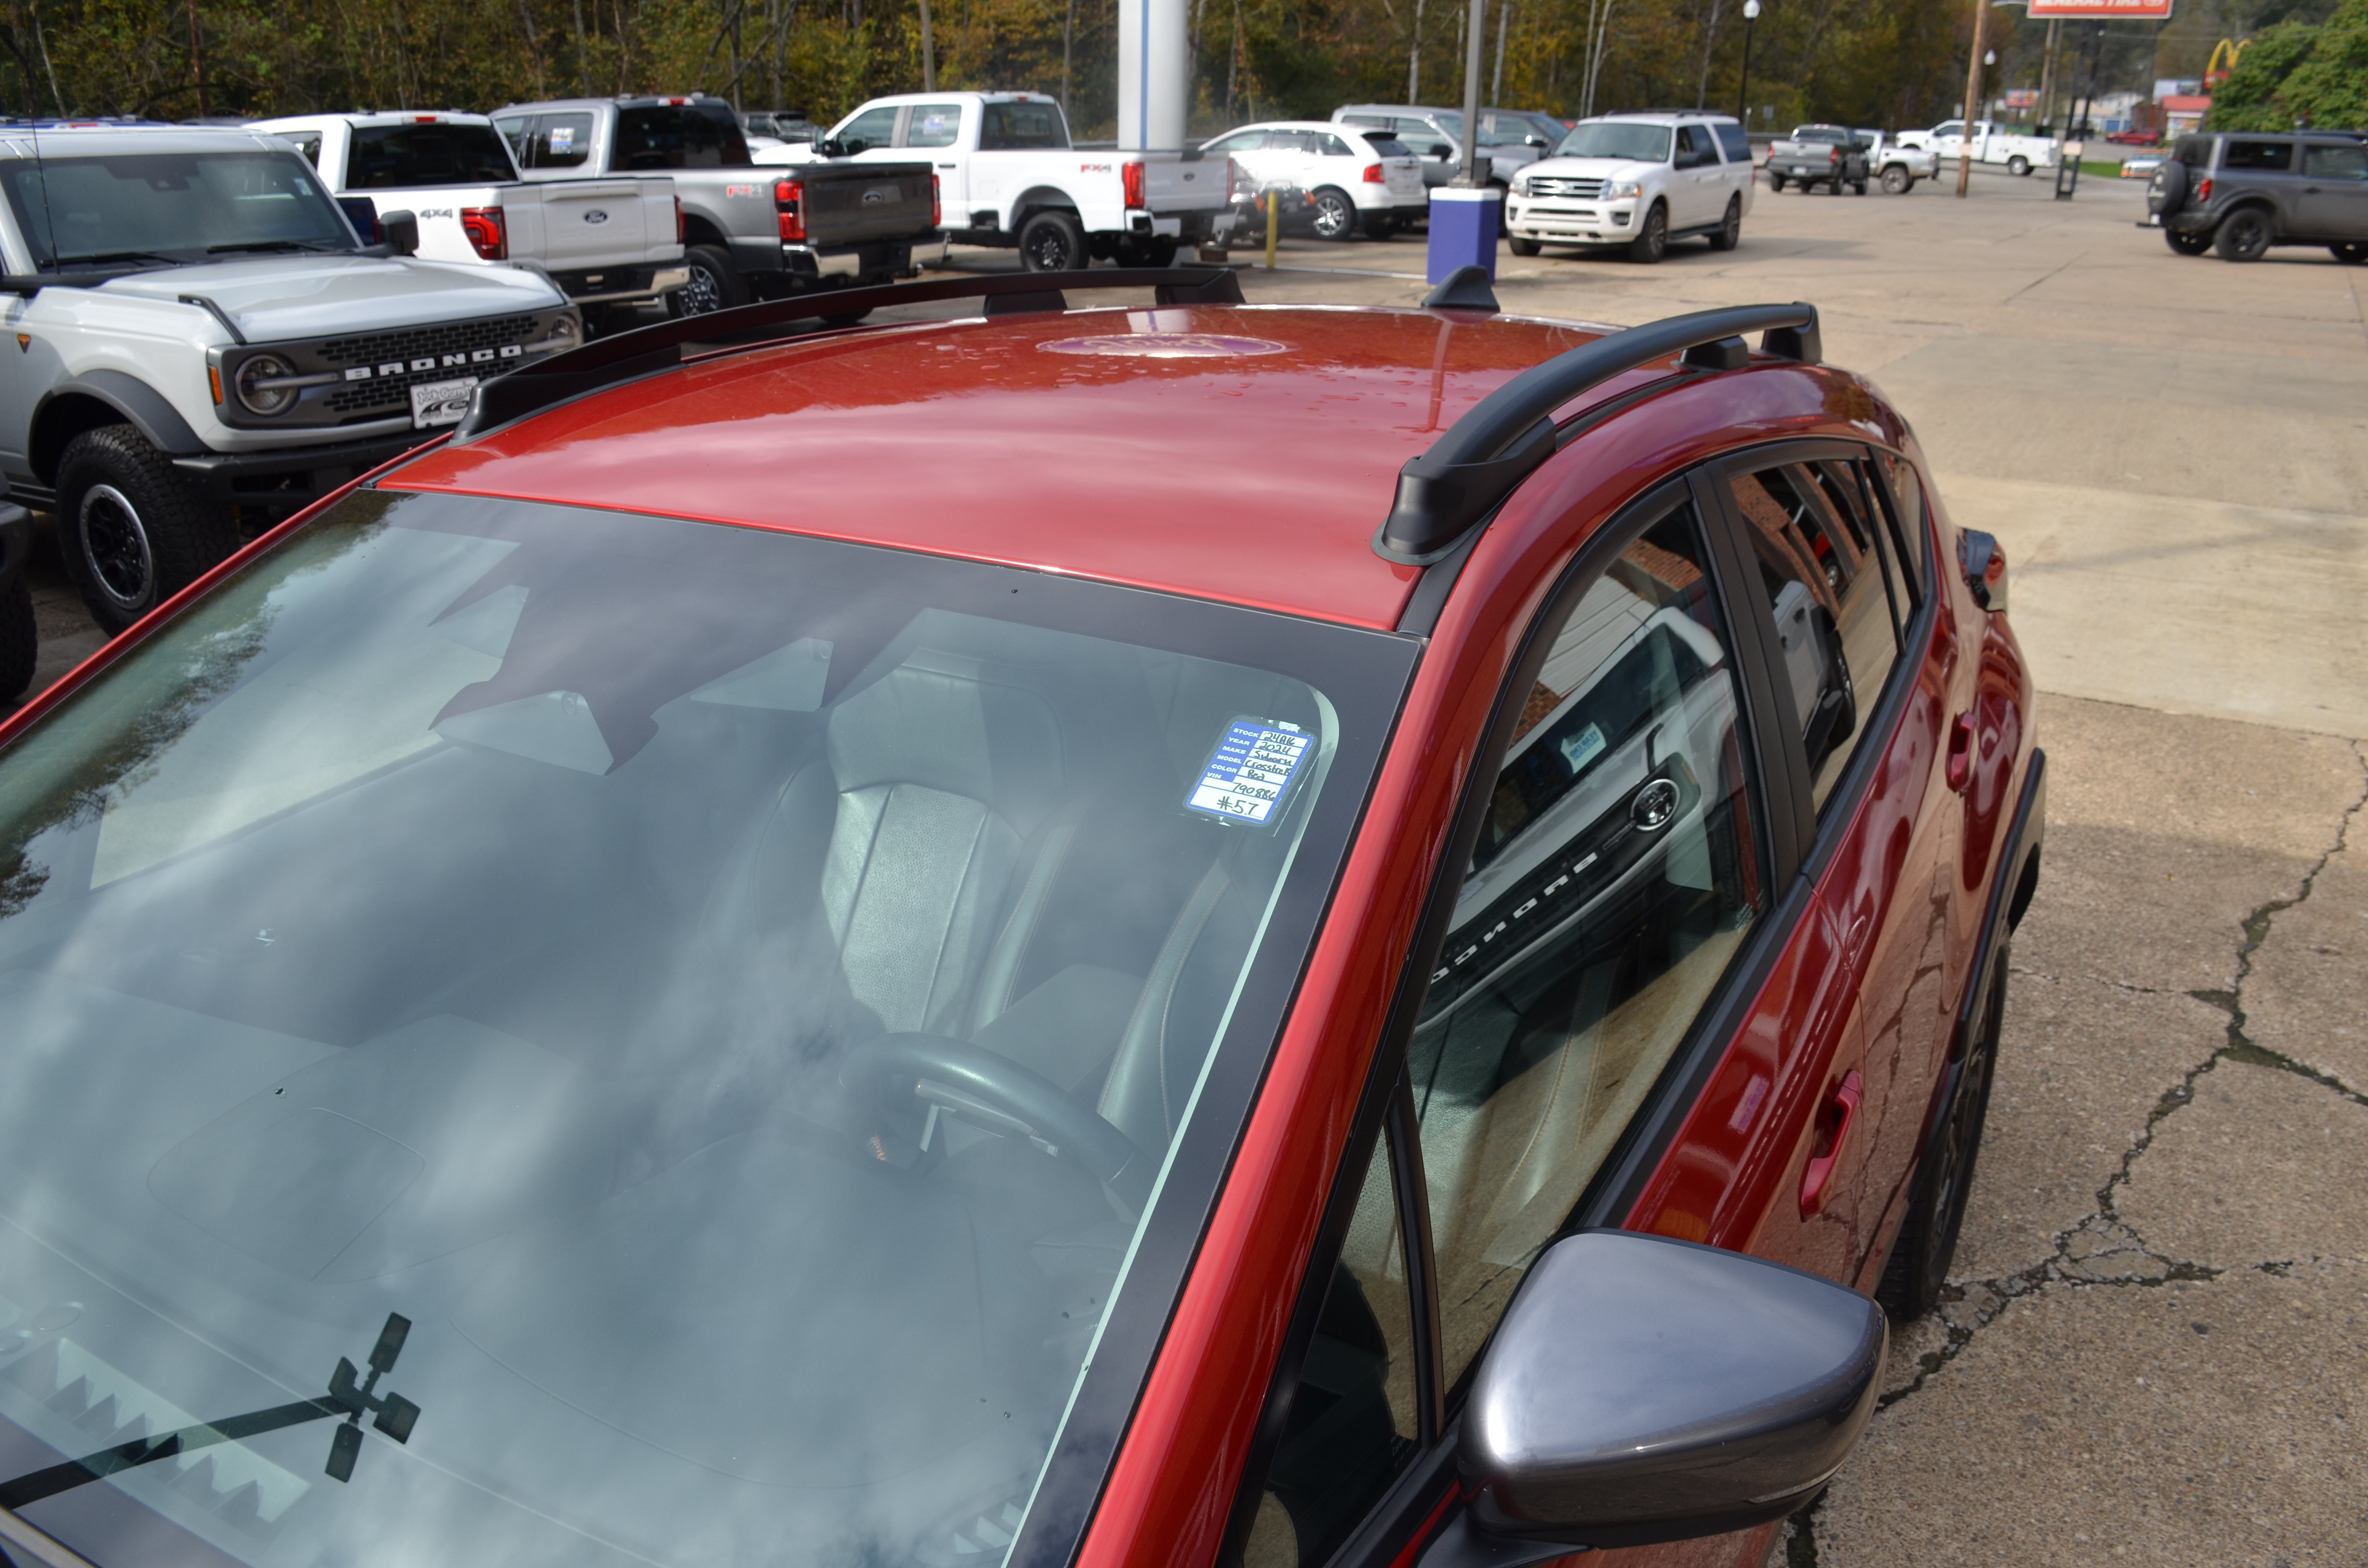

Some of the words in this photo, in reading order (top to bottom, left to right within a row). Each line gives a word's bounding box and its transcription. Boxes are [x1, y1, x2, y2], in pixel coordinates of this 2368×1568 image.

[345, 344, 521, 381] BRONCO
[1233, 728, 1259, 738] STOCK
[1222, 746, 1246, 754] MAKE
[1228, 737, 1250, 746] YEAR
[1258, 741, 1292, 754] 2024
[1217, 755, 1242, 764] MODEL
[1211, 764, 1237, 773] COLOR
[1247, 769, 1265, 781] Red
[1217, 796, 1259, 815] #57
